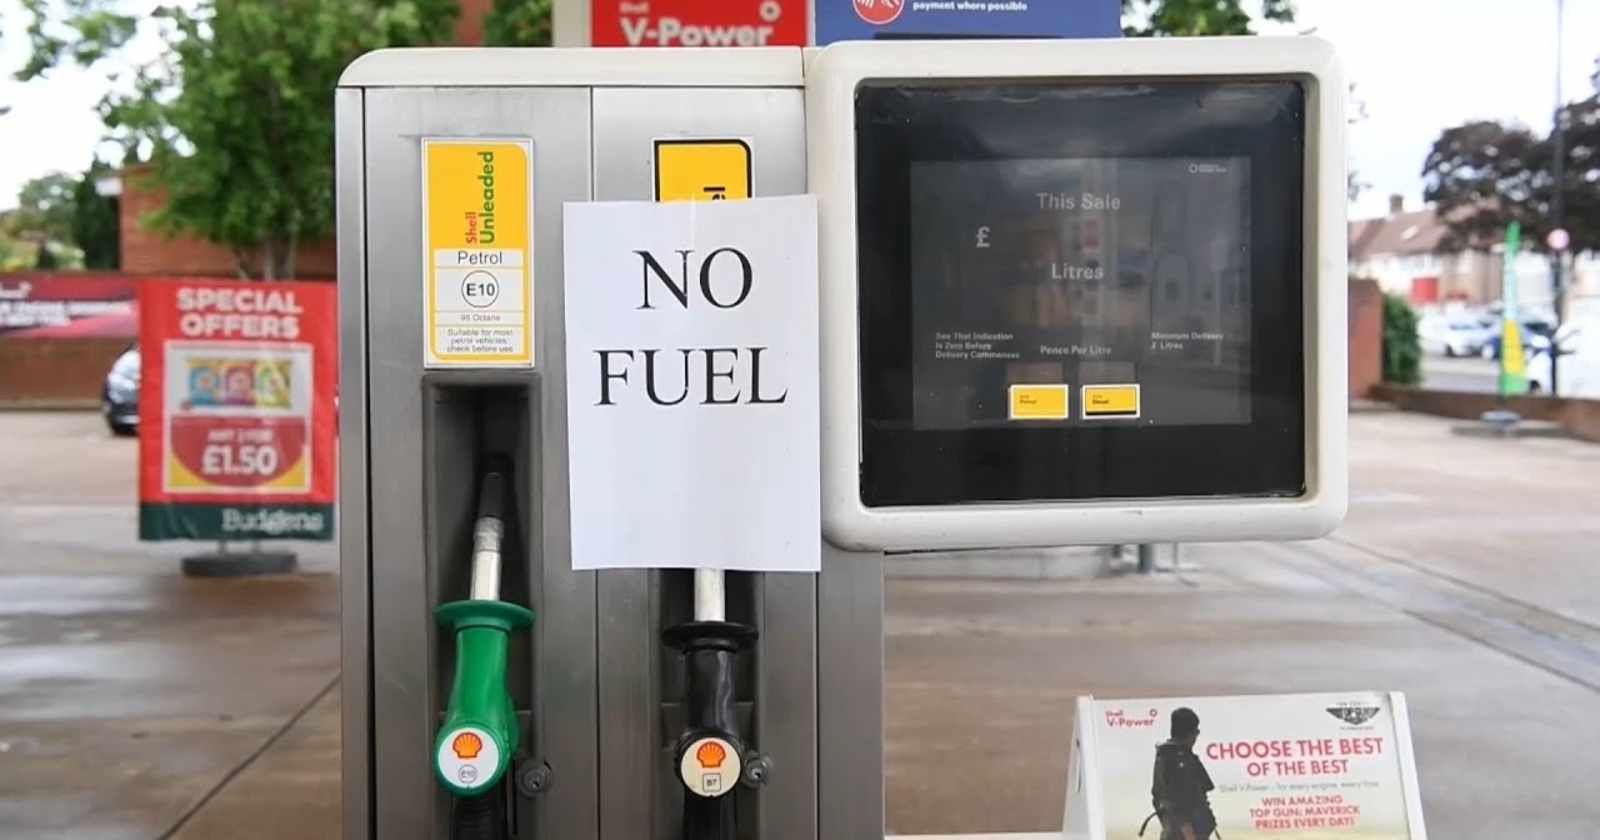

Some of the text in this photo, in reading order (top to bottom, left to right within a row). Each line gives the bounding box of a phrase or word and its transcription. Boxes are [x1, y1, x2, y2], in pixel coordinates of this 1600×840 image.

[912, 1, 955, 12] payment
[988, 1, 1028, 11] possible
[619, 17, 774, 46] V-Power
[477, 151, 495, 244] Unleaded
[1036, 192, 1121, 211] This Sale
[465, 211, 477, 244] Shell
[976, 225, 991, 248] £
[457, 250, 502, 265] Petrol
[632, 247, 754, 310] NO
[1051, 263, 1104, 280] Litres
[466, 283, 495, 296] E10
[177, 288, 303, 314] SPECIAL
[181, 314, 299, 339] OFFERS
[1039, 345, 1112, 356] Pence Per Litre
[593, 347, 789, 406] FUEL
[202, 445, 278, 476] £1.50
[221, 508, 324, 535] Budgens
[1106, 717, 1155, 728] V-Power
[1206, 737, 1384, 760] CHOOSE THE BEST
[1247, 759, 1349, 777] OF THE BEST
[1249, 807, 1271, 818] TOP
[1304, 804, 1360, 816] MAVERICK
[1261, 794, 1344, 807] WIN AMAZING
[1255, 818, 1292, 829] PRIZES
[1294, 816, 1326, 828] EVERY
